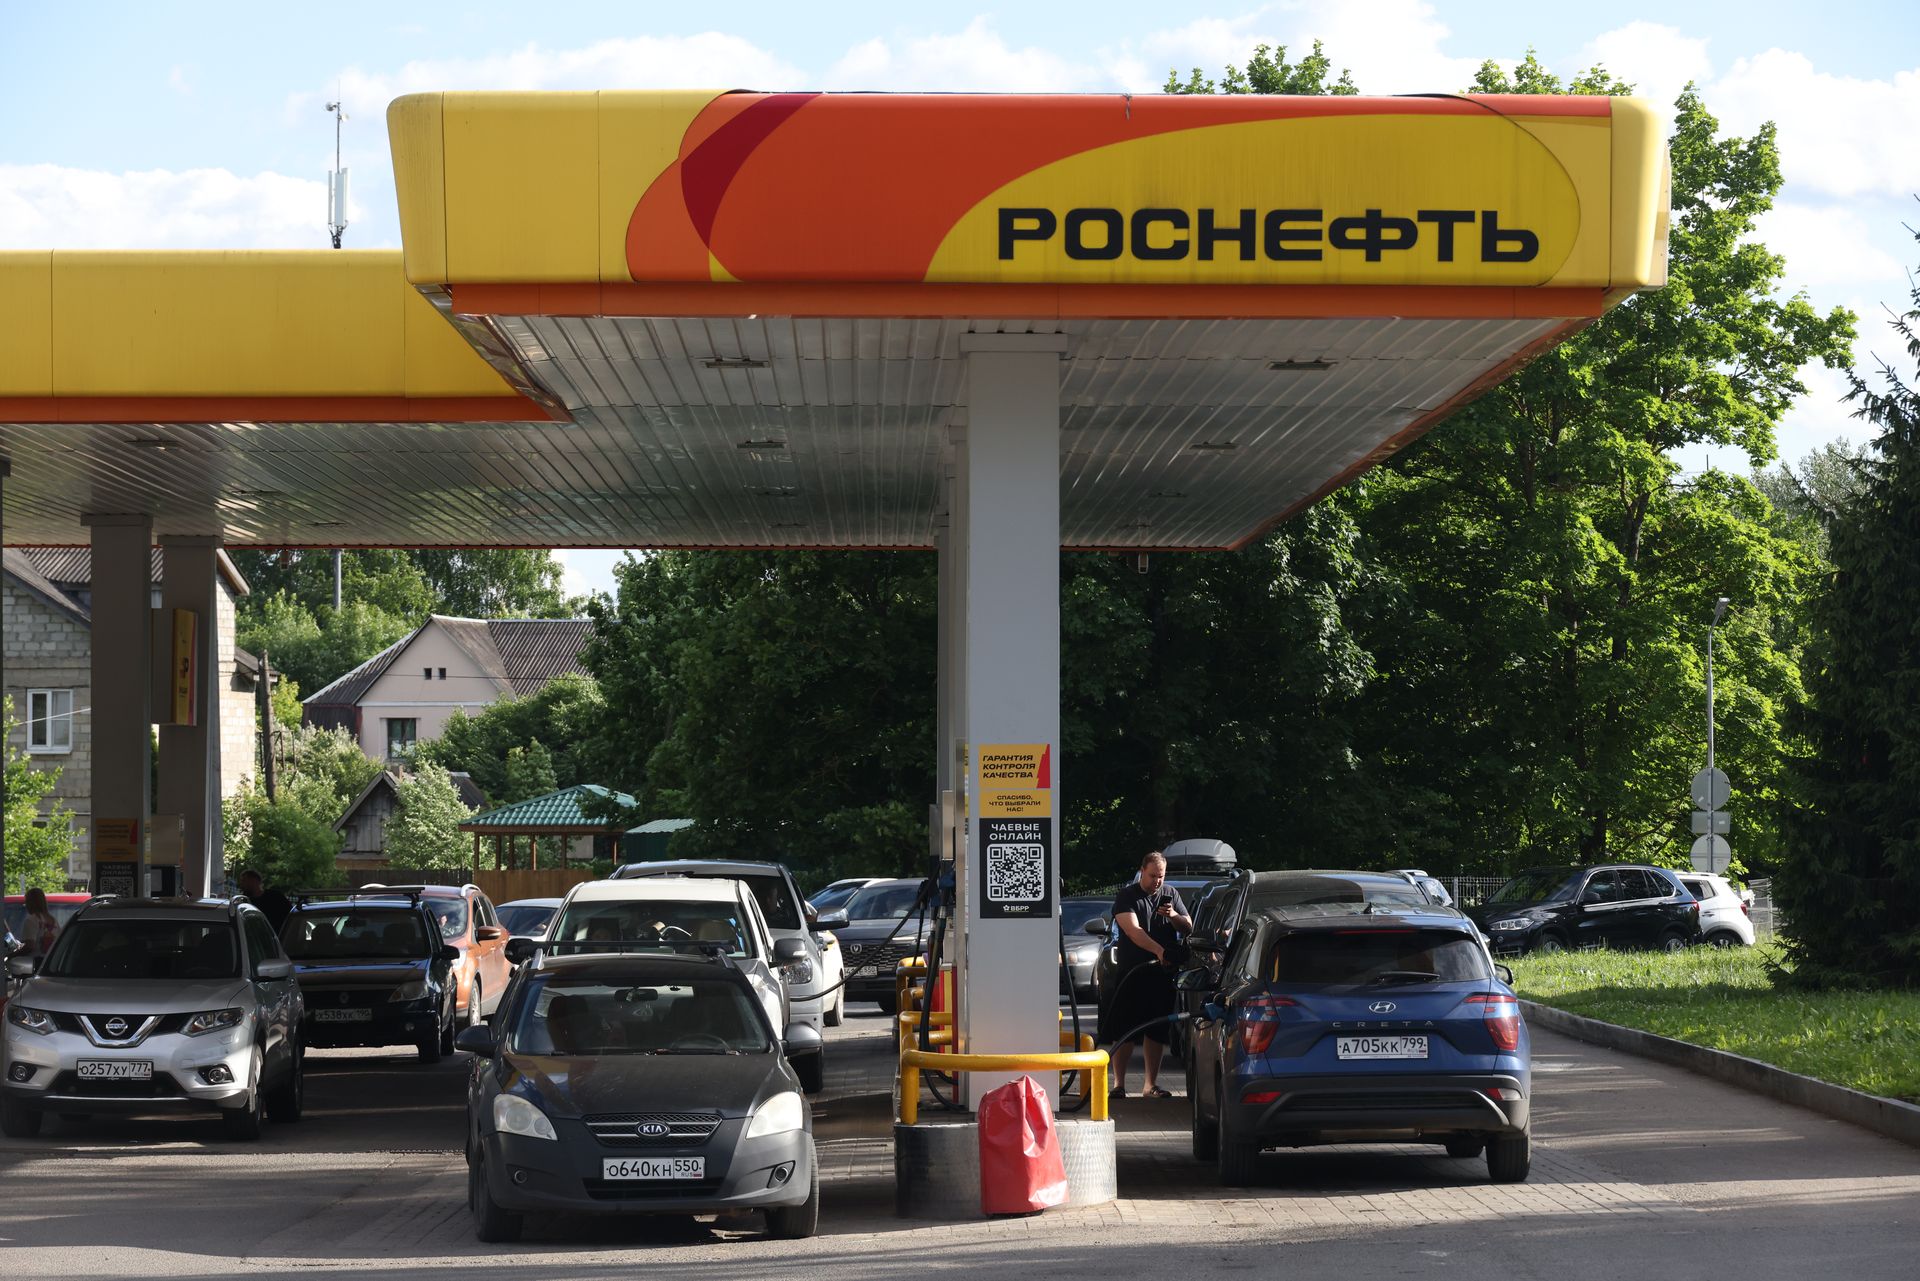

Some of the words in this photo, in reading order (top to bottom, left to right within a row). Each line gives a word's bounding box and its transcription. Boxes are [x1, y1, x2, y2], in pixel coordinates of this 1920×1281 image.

[998, 208, 1539, 262] РОСНЕФТЬ
[991, 823, 1040, 831] ЧАЕВЫЕ
[989, 832, 1042, 841] ОНЛАЙН
[1402, 1038, 1424, 1048] 799
[130, 1063, 148, 1072] 777
[643, 1125, 663, 1133] KIA
[675, 1160, 699, 1172] 550
